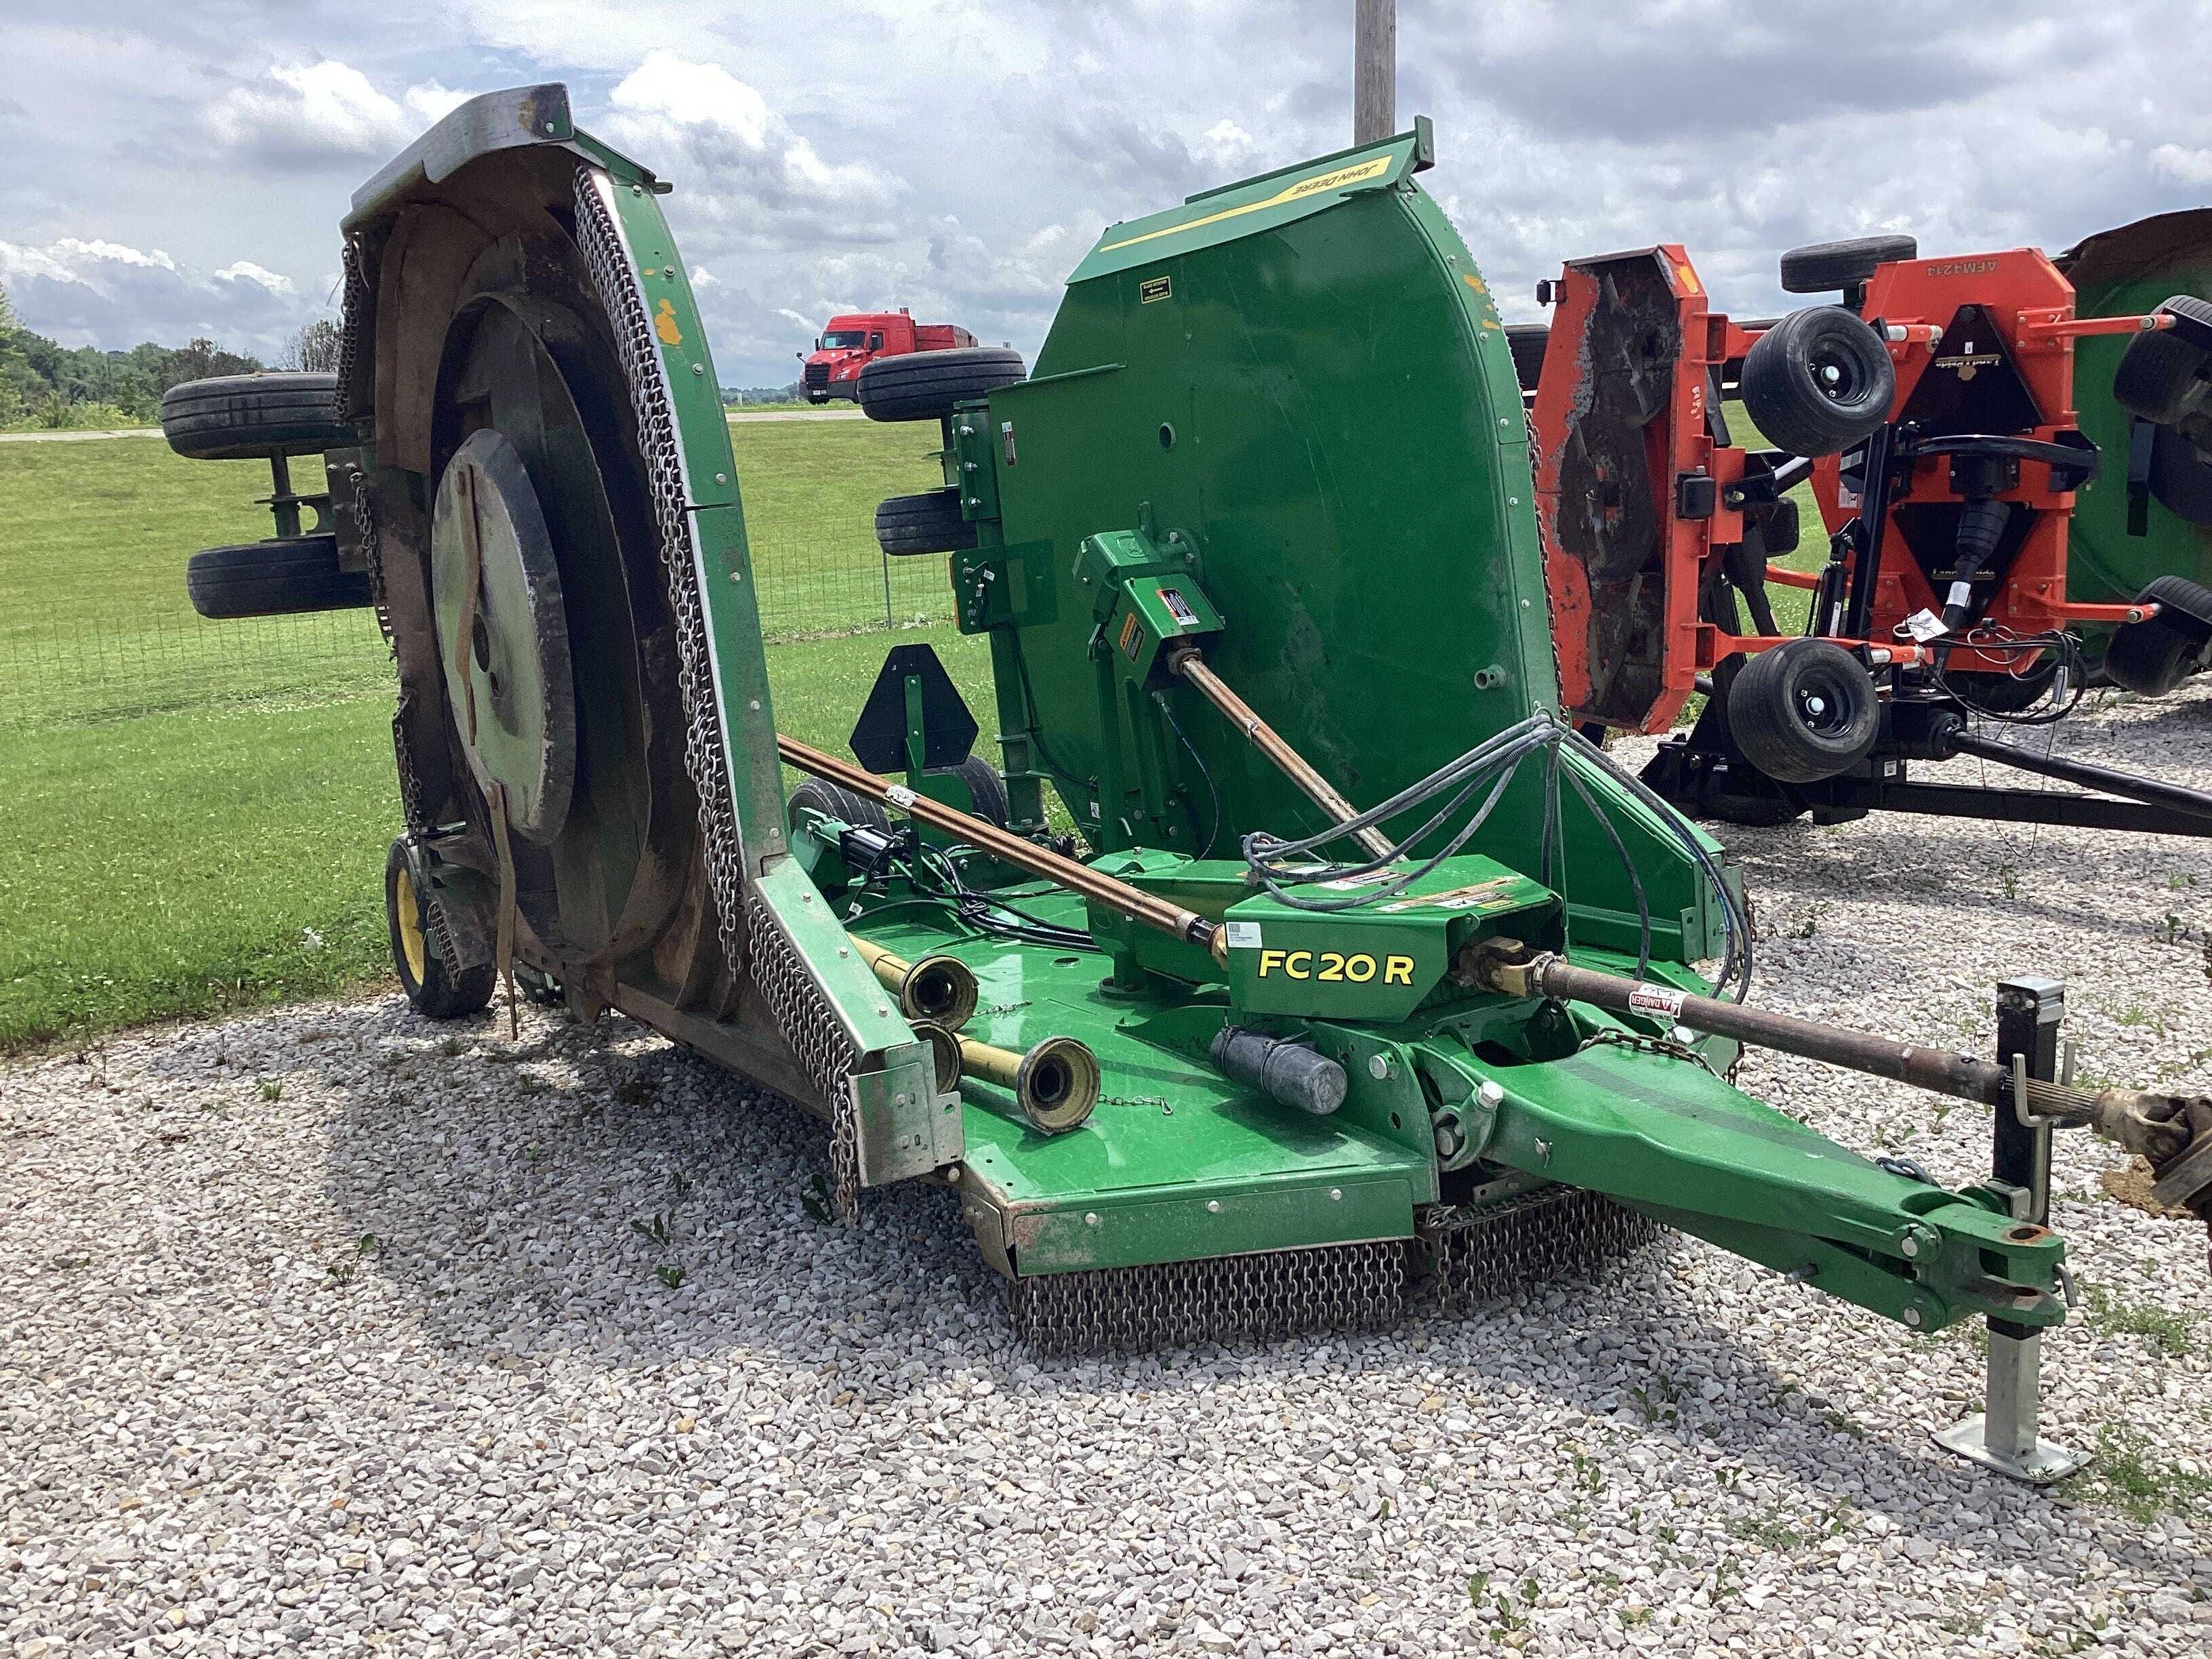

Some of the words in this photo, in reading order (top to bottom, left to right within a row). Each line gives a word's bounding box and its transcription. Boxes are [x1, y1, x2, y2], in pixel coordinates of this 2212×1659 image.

[1338, 164, 1378, 182] JOHN
[1292, 175, 1339, 195] DEERE
[1927, 260, 1998, 276] AFM4214
[1632, 996, 1660, 1008] DANGER
